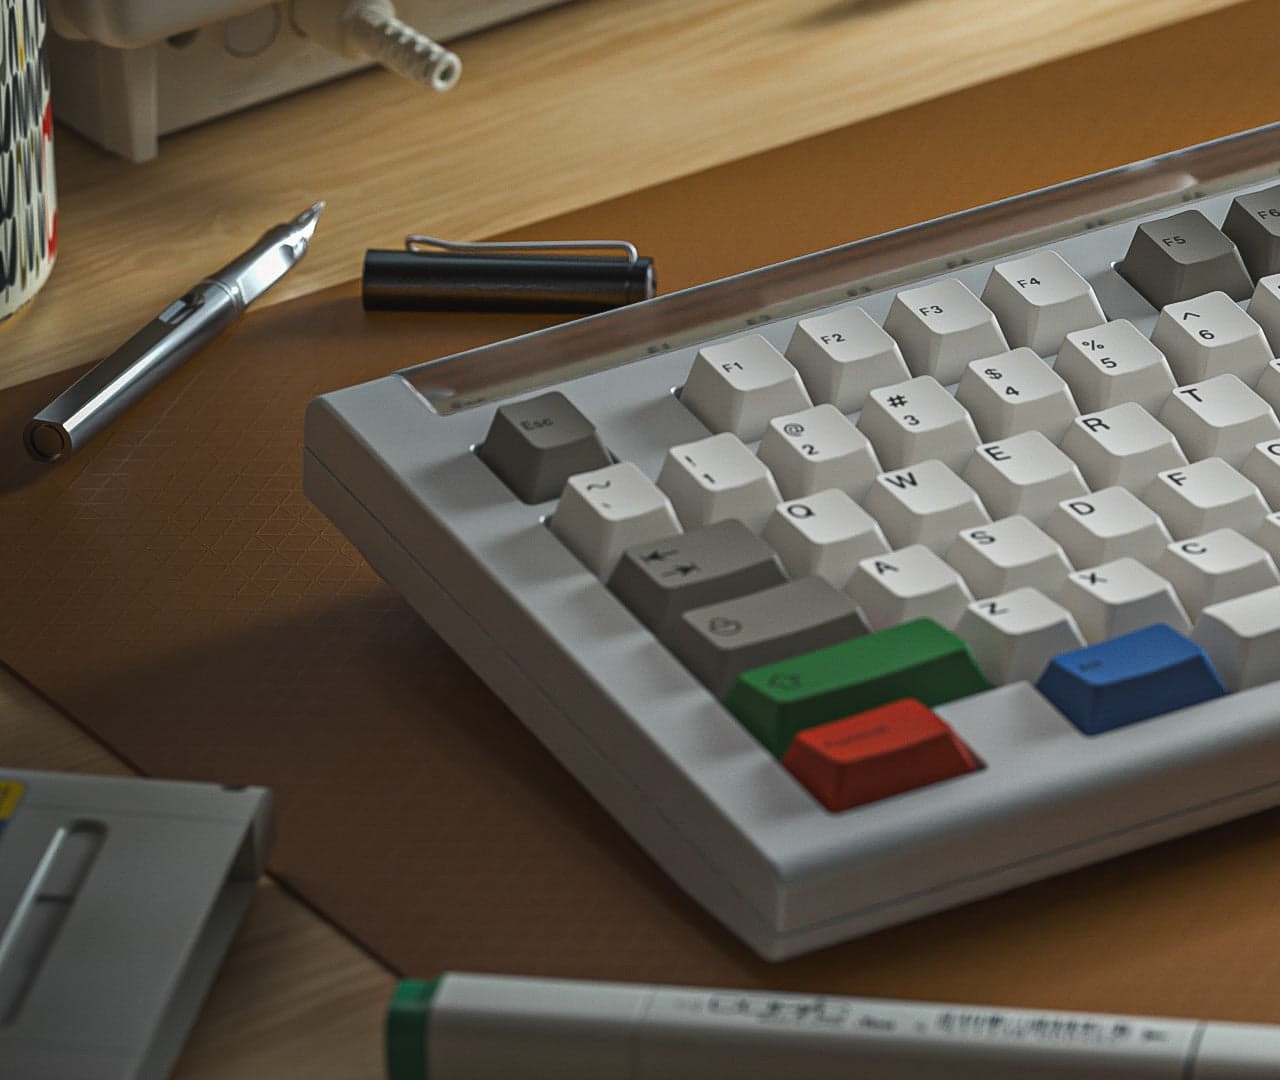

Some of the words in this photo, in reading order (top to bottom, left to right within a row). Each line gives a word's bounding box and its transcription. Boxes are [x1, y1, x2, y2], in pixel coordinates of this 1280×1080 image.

[1161, 234, 1187, 248] F5
[1016, 276, 1042, 290] F4
[919, 304, 944, 317] F3
[820, 332, 846, 345] F2
[1198, 329, 1216, 342] 6
[1081, 338, 1106, 352] %
[721, 360, 745, 374] F1
[1099, 356, 1118, 370] 5
[984, 367, 1004, 381] $
[1003, 385, 1021, 398] 4
[1179, 386, 1204, 403] T
[886, 394, 908, 409] #
[520, 417, 554, 431] Esc
[903, 414, 921, 427] 3
[1082, 416, 1111, 433] R
[783, 422, 806, 437] @
[801, 443, 820, 456] 2
[984, 445, 1012, 462] E
[885, 471, 919, 490] W
[1166, 470, 1190, 486] F
[786, 503, 817, 519] Q
[1067, 501, 1096, 516] D
[969, 529, 996, 546] S
[1180, 541, 1208, 557] C
[872, 560, 900, 576] A
[1077, 572, 1109, 587] X
[978, 601, 1010, 618] Z
